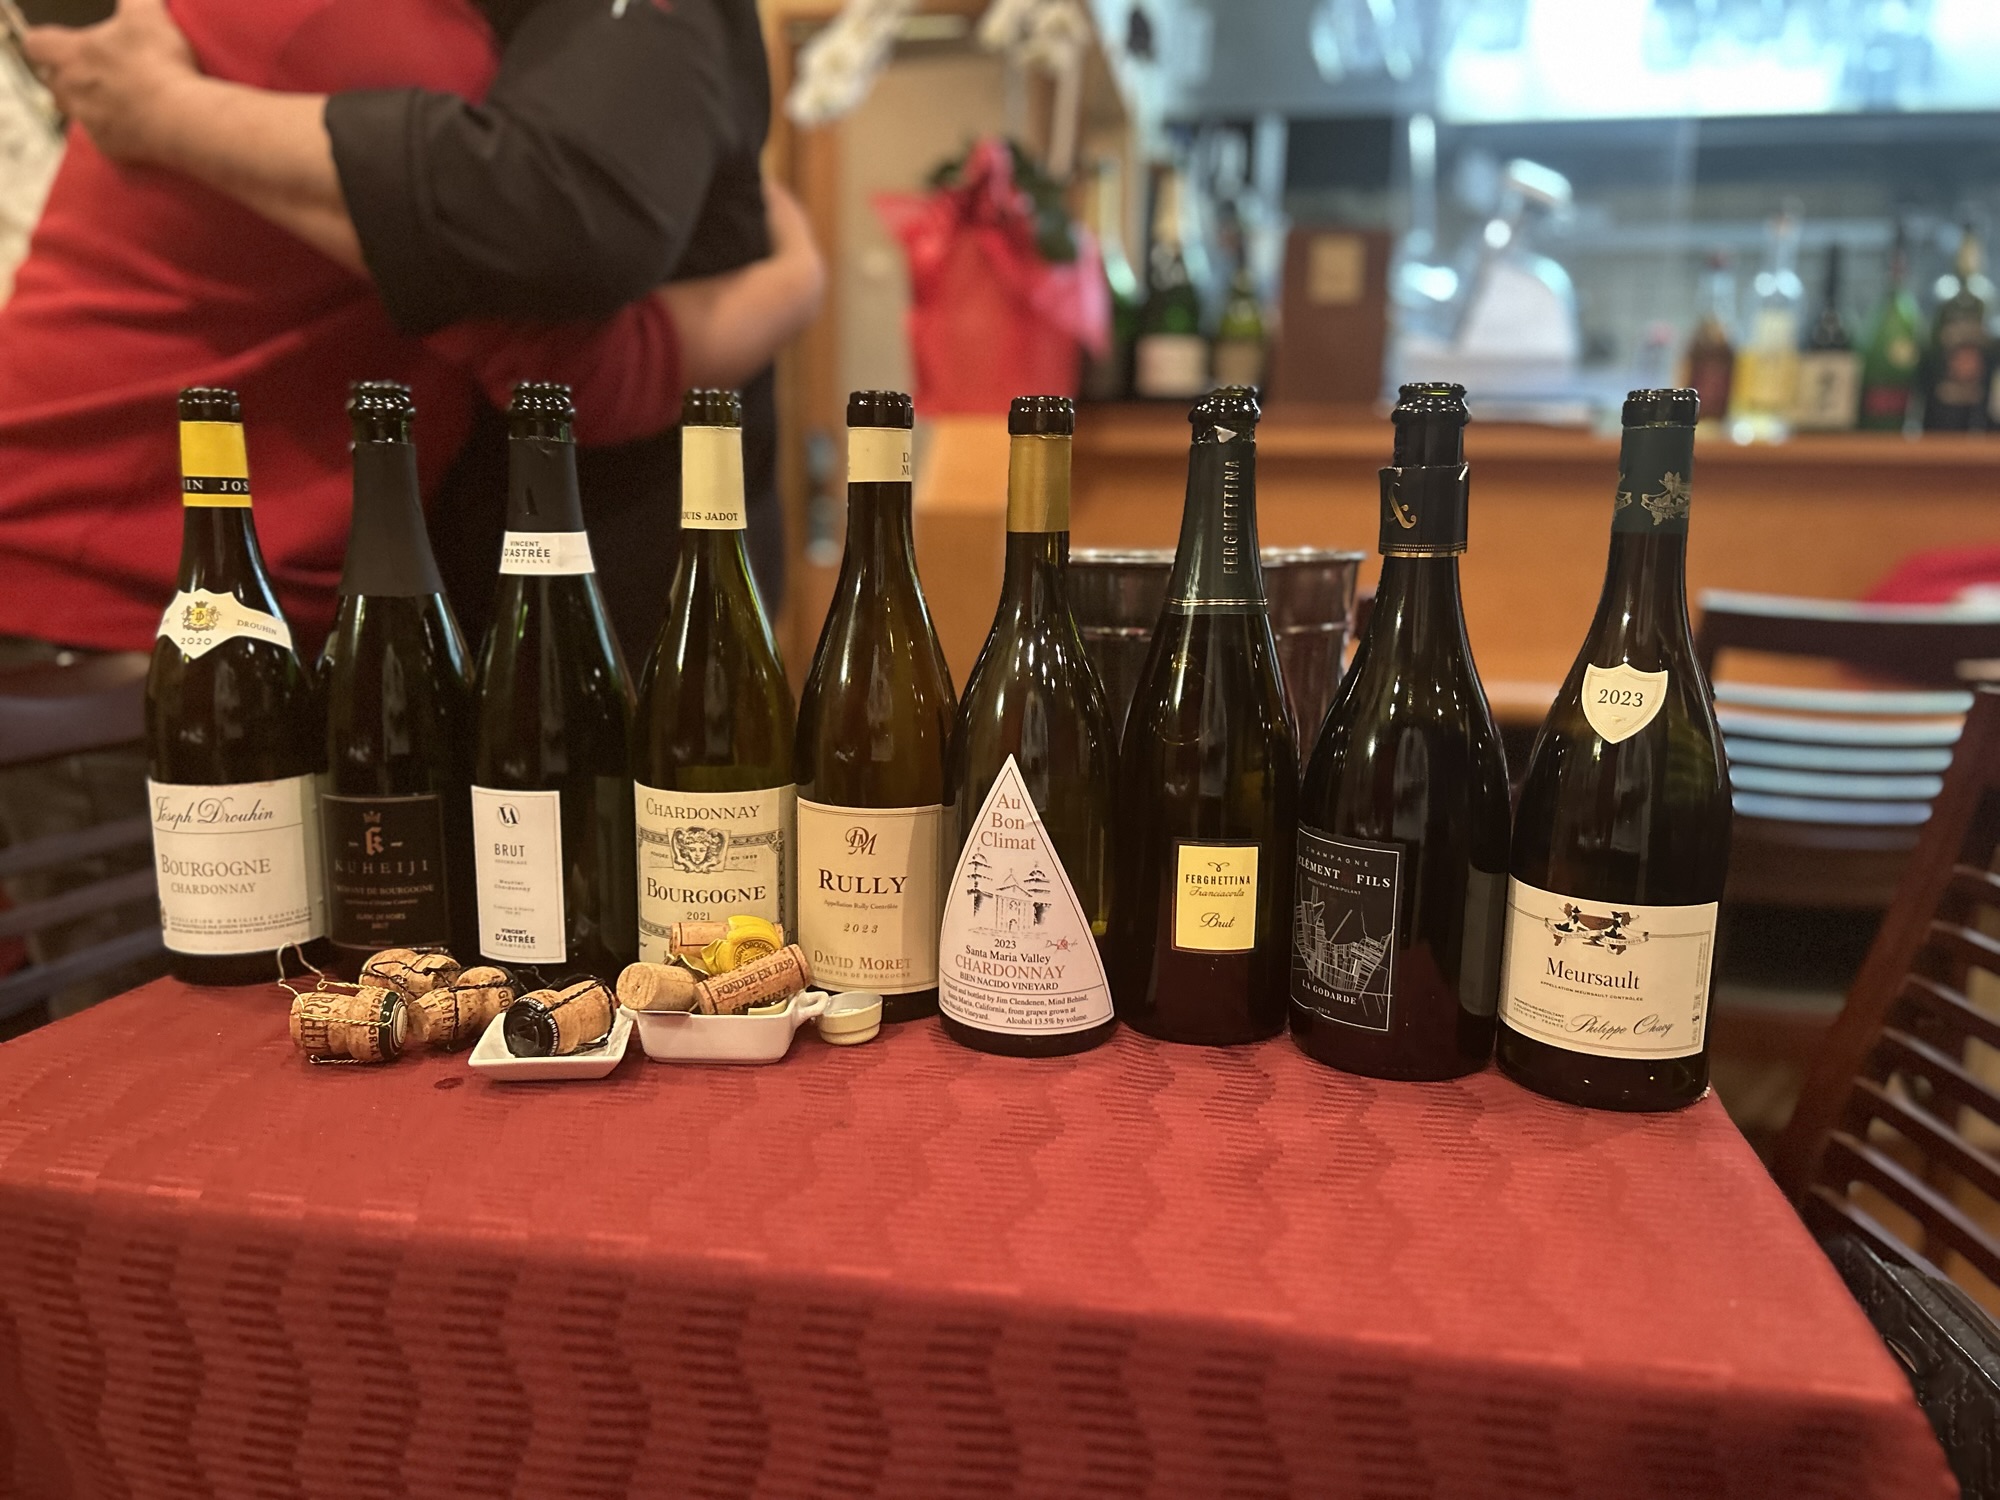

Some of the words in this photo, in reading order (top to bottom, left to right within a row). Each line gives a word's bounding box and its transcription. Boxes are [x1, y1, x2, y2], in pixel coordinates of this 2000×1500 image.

[704, 512, 739, 521] JADOT
[1222, 459, 1240, 575] FERGHETTINA
[236, 619, 278, 636] DROUHIN
[180, 637, 213, 646] 2020
[1597, 688, 1644, 708] 2023
[645, 797, 761, 821] CHARDONNAY
[996, 793, 1022, 810] Au
[156, 796, 195, 830] Joseph
[197, 796, 274, 824] Drouhin
[991, 812, 1026, 830] Bon
[980, 831, 1037, 851] Climat
[494, 843, 525, 857] BRUT
[1305, 845, 1369, 868] CHAMPAGNE
[161, 853, 272, 878] BOURGOGNE
[170, 881, 257, 895] CHARDONNAY
[818, 868, 909, 895] RULLY
[1185, 873, 1251, 886] FERGHETTINA
[1356, 873, 1391, 888] FILS
[646, 876, 767, 904] BOURGOGNE
[1189, 885, 1245, 898] Franciacorta
[853, 902, 869, 911] Rully
[686, 911, 711, 921] 2021
[1200, 912, 1236, 928] Brut
[501, 927, 527, 935] VINCENT
[843, 922, 879, 934] 2023
[495, 933, 536, 944] D'ASTRÉE
[994, 938, 1017, 949] 2023
[814, 949, 854, 969] DAVID
[859, 956, 912, 971] MORET
[965, 944, 988, 959] Santa
[989, 950, 1018, 963] Maria
[1020, 953, 1051, 965] Valley
[774, 957, 794, 975] 1859
[955, 954, 1066, 980] CHARDONNAY
[1545, 956, 1640, 990] Meursault
[959, 971, 976, 983] BIEN
[976, 976, 1010, 989] NACIDO
[1011, 982, 1059, 991] VINEYARD
[967, 990, 986, 1000] bottled
[986, 994, 995, 1003] by
[996, 996, 1008, 1004] Jim
[1009, 997, 1048, 1006] Clendenen,
[1047, 997, 1066, 1005] Mind
[1302, 978, 1311, 990] LA
[1312, 984, 1357, 1005] GODARDE
[1540, 981, 1574, 993] APPELLATION
[1574, 989, 1609, 999] MEURSAULT
[974, 1001, 1008, 1014] California,
[1008, 1007, 1025, 1015] from
[1025, 1009, 1048, 1017] grapes
[1048, 1008, 1070, 1016] grown
[1006, 1016, 1033, 1025] Alcohol
[1034, 1017, 1055, 1025] 13.5%
[1056, 1017, 1065, 1026] by
[1564, 1013, 1628, 1040] Philippe
[1633, 1013, 1675, 1038] Chavy
